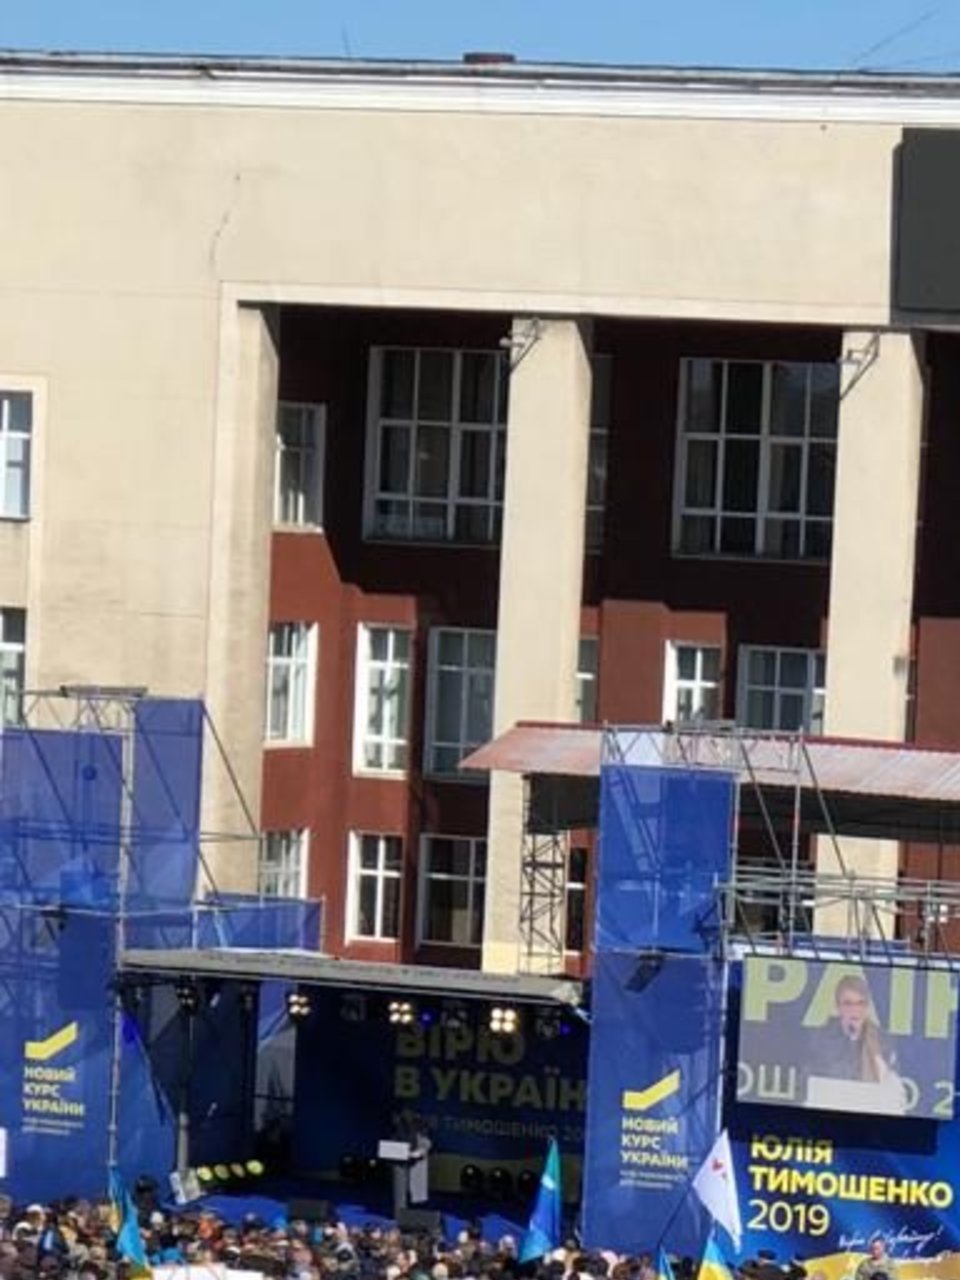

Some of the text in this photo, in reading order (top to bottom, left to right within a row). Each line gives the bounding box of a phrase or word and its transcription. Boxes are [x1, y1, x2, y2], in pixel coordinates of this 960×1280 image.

[23, 1083, 60, 1098] КУРС
[622, 1117, 678, 1134] НОВИЙ
[622, 1134, 660, 1150] КУРС
[751, 1135, 833, 1164] ЮЛІЯ
[621, 1150, 688, 1168] УКРАЇНИ
[748, 1165, 954, 1208] ТИМОШЕНКО
[747, 1200, 830, 1236] 2019
